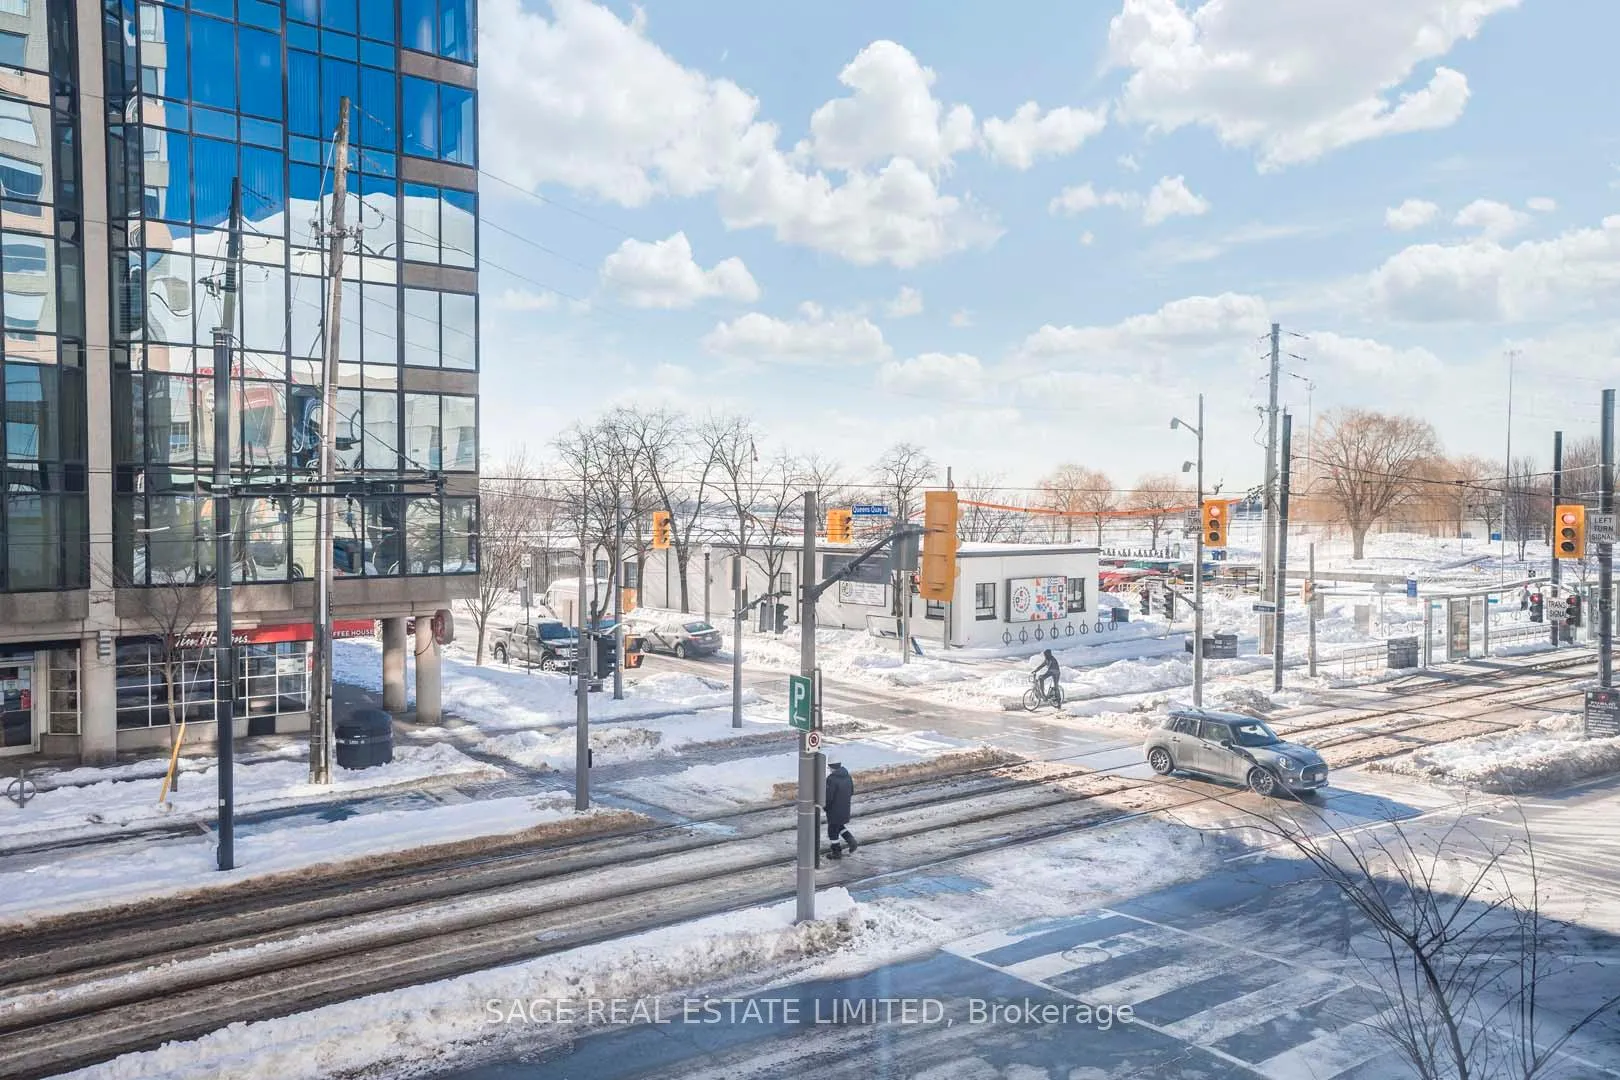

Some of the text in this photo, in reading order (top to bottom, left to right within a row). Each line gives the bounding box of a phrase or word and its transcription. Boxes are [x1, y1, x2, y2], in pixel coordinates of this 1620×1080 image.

[853, 505, 870, 513] Queens
[871, 506, 882, 514] Quay
[1593, 525, 1614, 533] TURN
[1591, 533, 1613, 541] SIGNAL
[1548, 600, 1566, 609] TRANS
[174, 632, 198, 648] Tim
[794, 682, 805, 709] P
